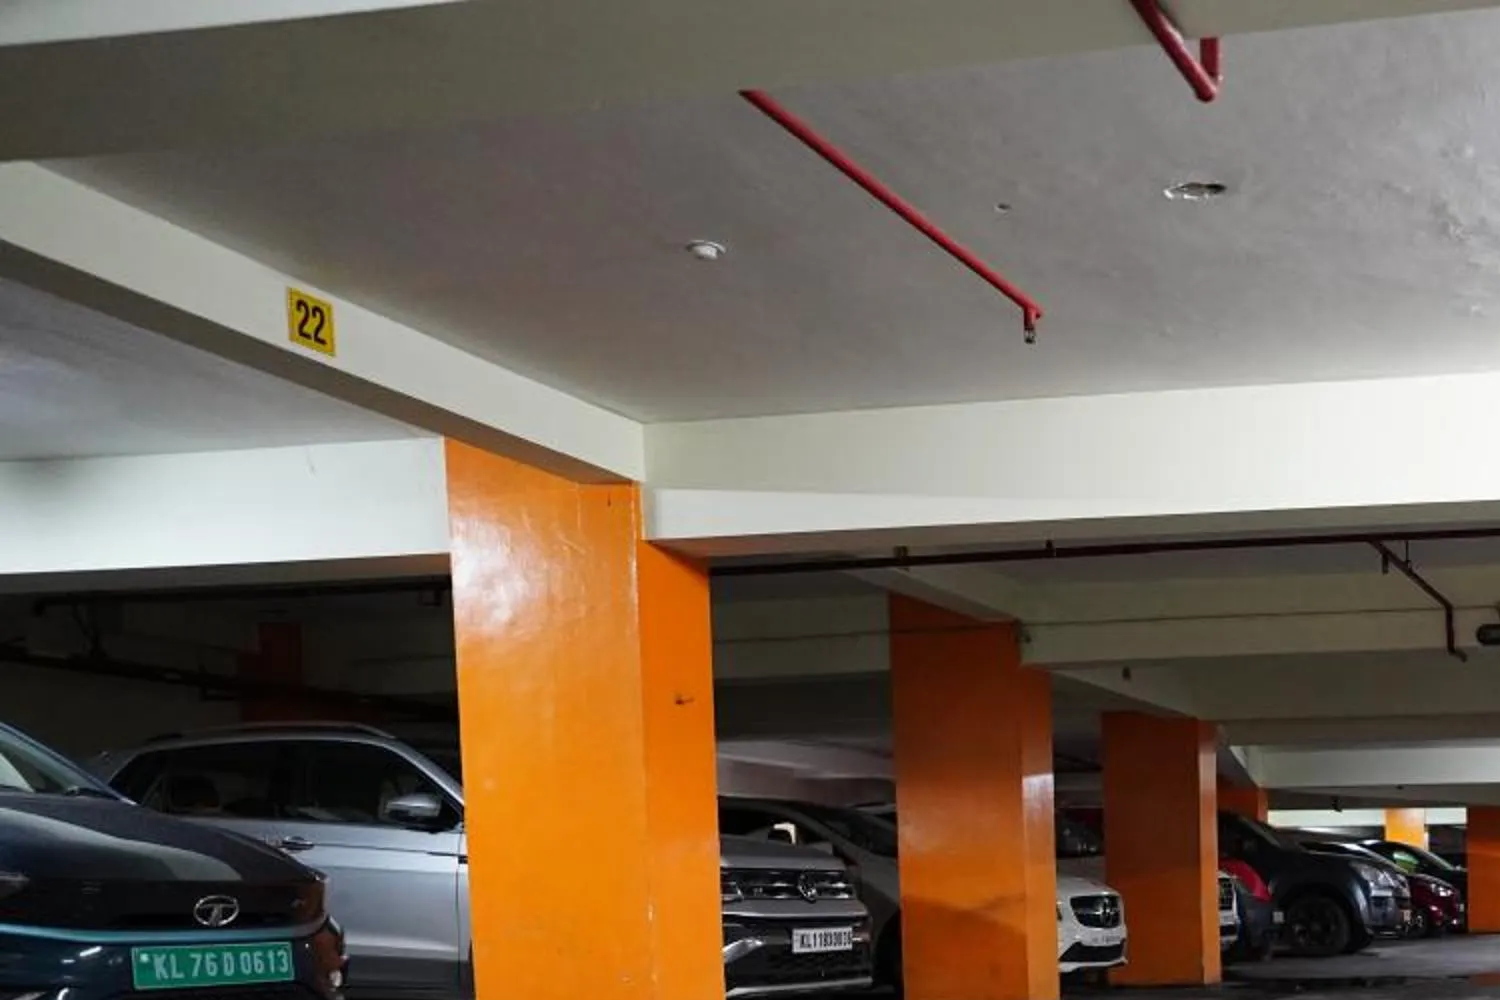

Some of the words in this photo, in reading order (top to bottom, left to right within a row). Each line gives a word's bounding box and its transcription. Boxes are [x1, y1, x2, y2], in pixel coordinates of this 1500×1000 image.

[296, 299, 328, 345] 22
[153, 953, 185, 981] KL
[189, 952, 218, 978] 76
[240, 950, 289, 975] 0613
